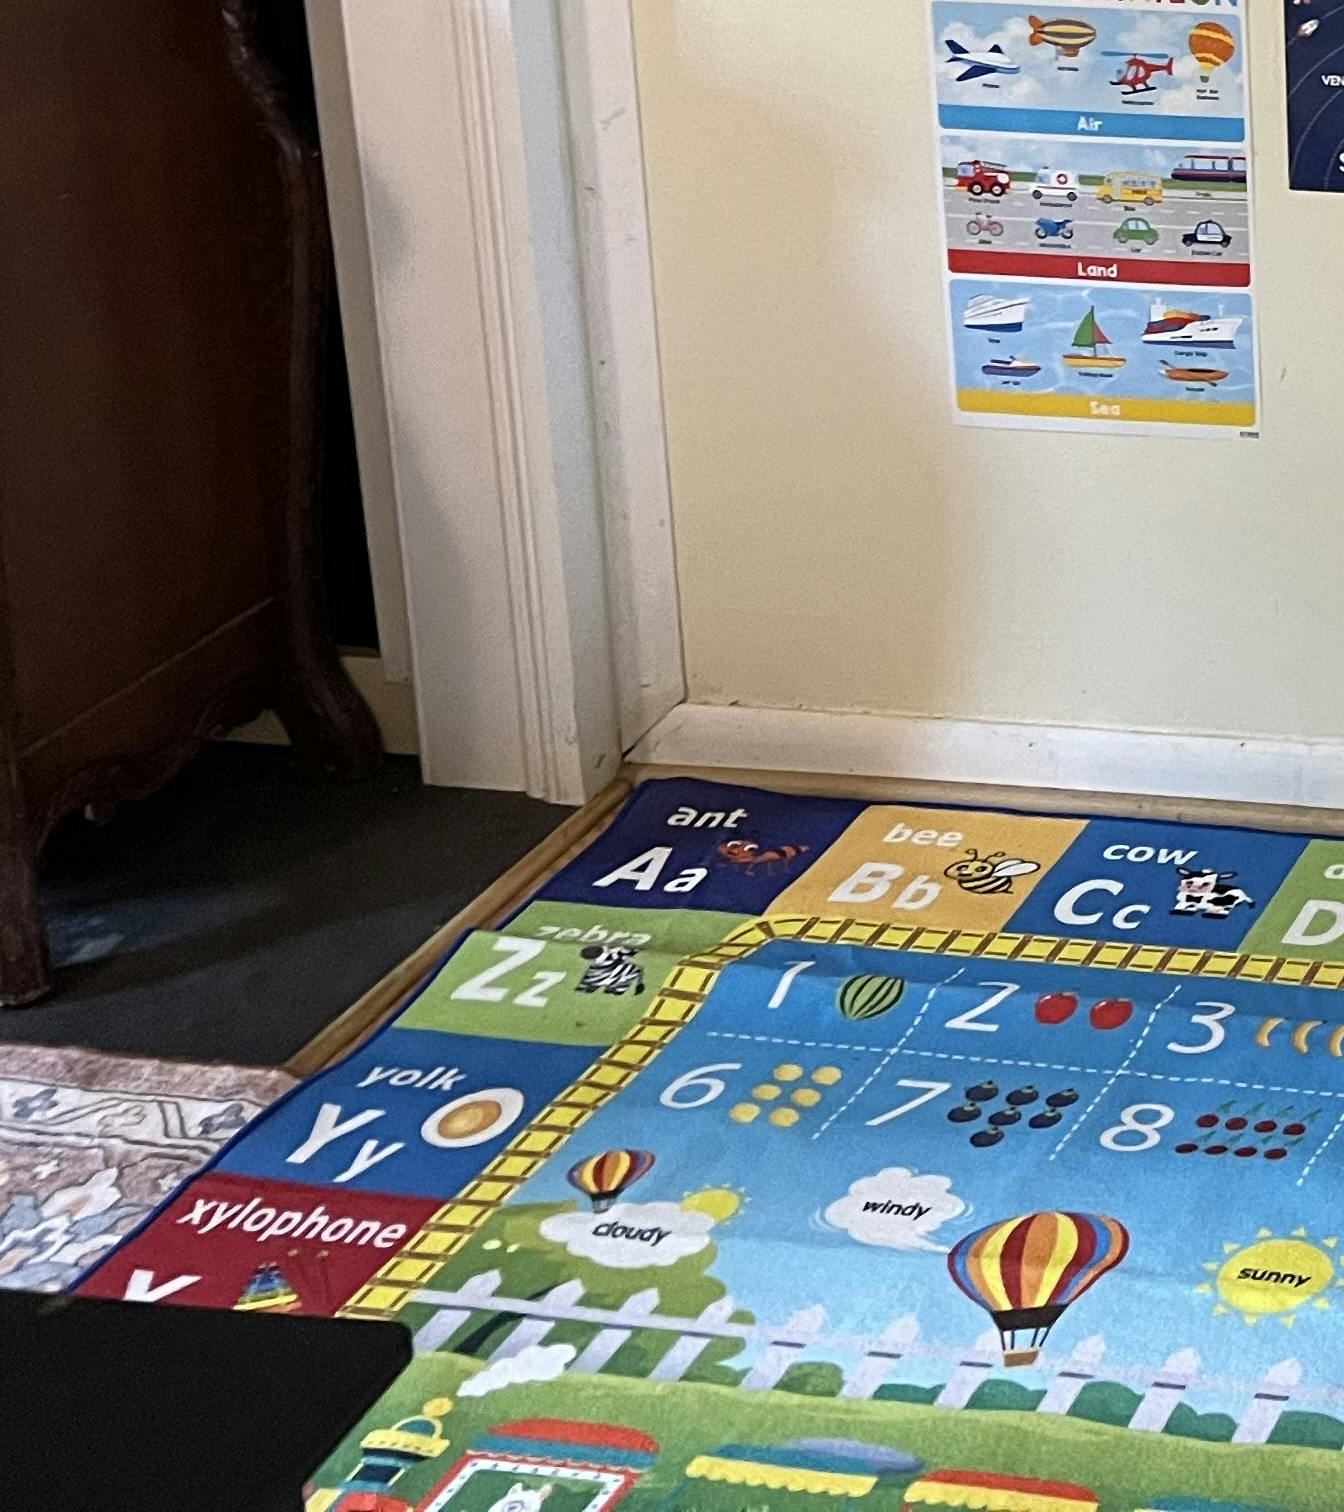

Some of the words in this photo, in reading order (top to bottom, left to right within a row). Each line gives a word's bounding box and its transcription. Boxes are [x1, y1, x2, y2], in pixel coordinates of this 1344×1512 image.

[1077, 116, 1103, 131] Air
[1077, 262, 1118, 278] Land
[1089, 400, 1121, 416] Sea
[667, 805, 751, 830] ant
[883, 822, 964, 848] bee
[1102, 842, 1199, 866] cow
[592, 845, 709, 893] Aa
[827, 862, 943, 911] Bb
[1053, 878, 1151, 930] Cc
[450, 935, 568, 1008] Zz
[768, 961, 816, 1009] 1
[944, 981, 1021, 1032] 2
[1166, 1001, 1236, 1055] 3
[356, 1065, 467, 1091] yolk
[659, 1063, 742, 1110] 6
[865, 1079, 953, 1127] 7
[1099, 1103, 1175, 1152] 8
[286, 1103, 406, 1183] Yy
[862, 1199, 932, 1220] windy
[176, 1197, 408, 1250] xylophone
[592, 1221, 672, 1246] cloudy
[1237, 1266, 1313, 1288] sunny
